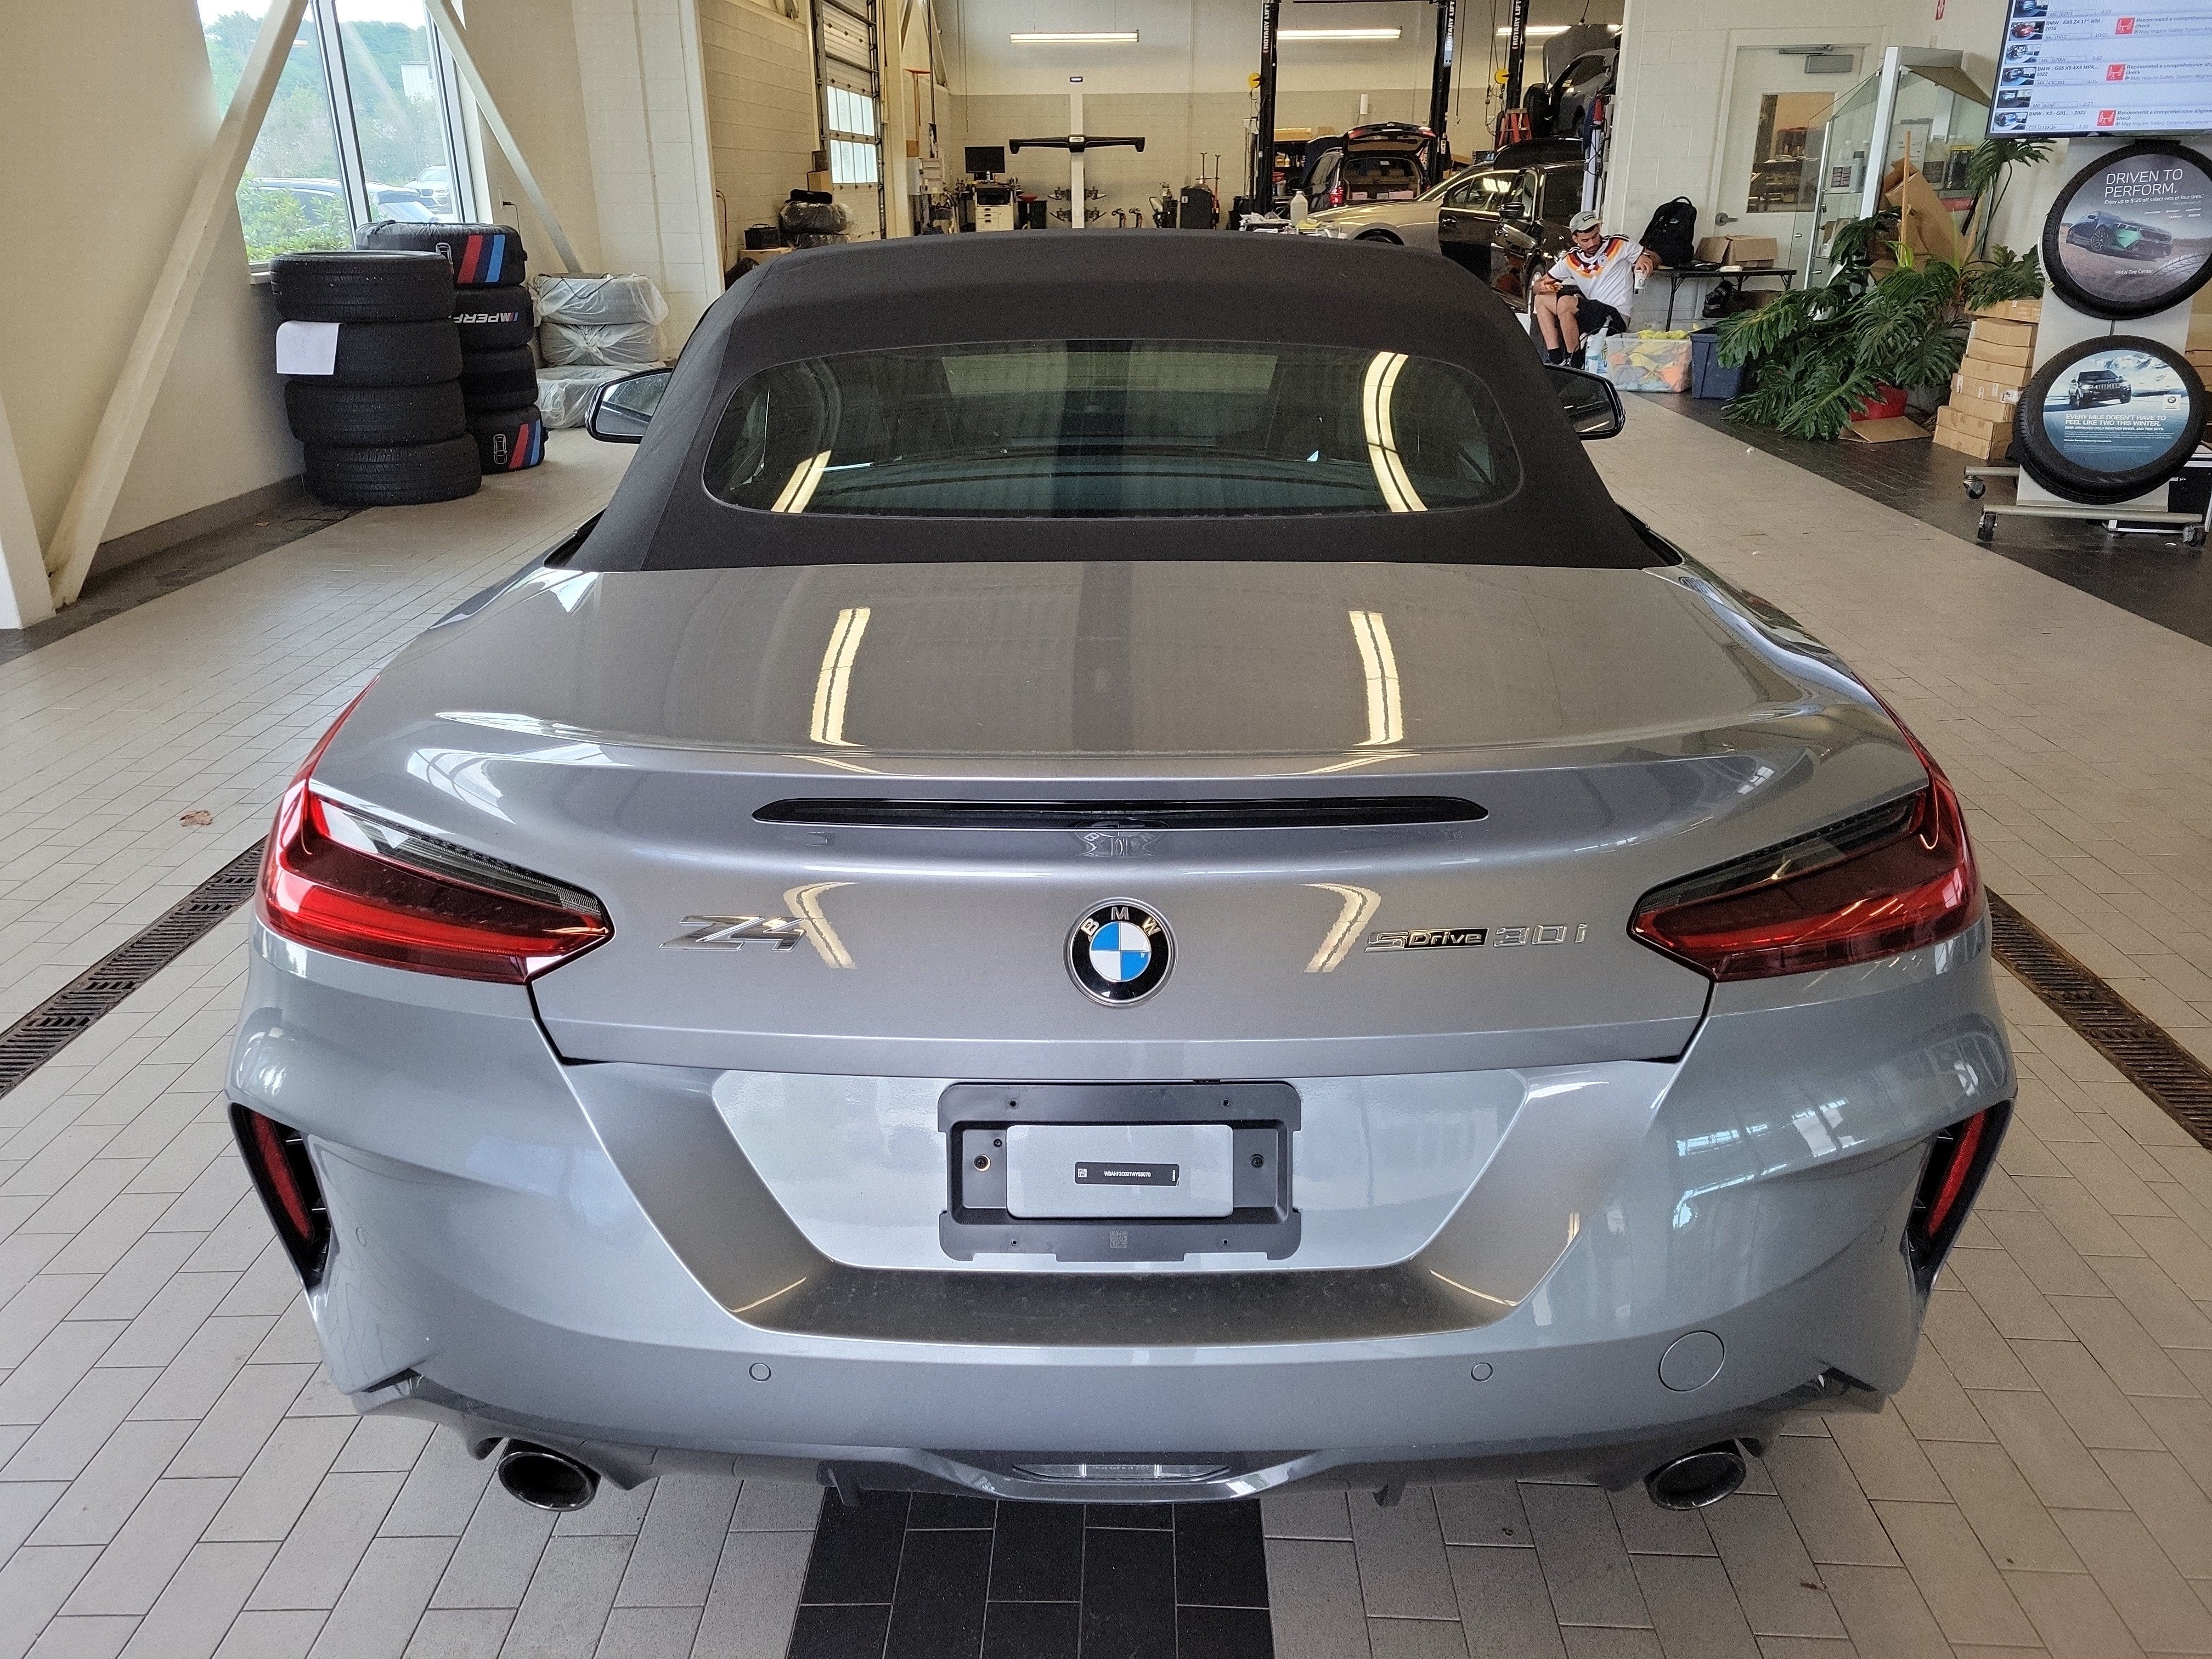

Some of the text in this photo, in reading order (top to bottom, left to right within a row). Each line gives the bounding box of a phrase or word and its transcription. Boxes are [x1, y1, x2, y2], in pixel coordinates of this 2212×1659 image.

[1512, 17, 1520, 46] ROTARY
[2104, 182, 2177, 198] PERFORM.
[2106, 168, 2183, 185] DRIVEN TO
[658, 915, 808, 952] Z4
[1080, 906, 1161, 937] BMW
[1493, 923, 1588, 948] 30i
